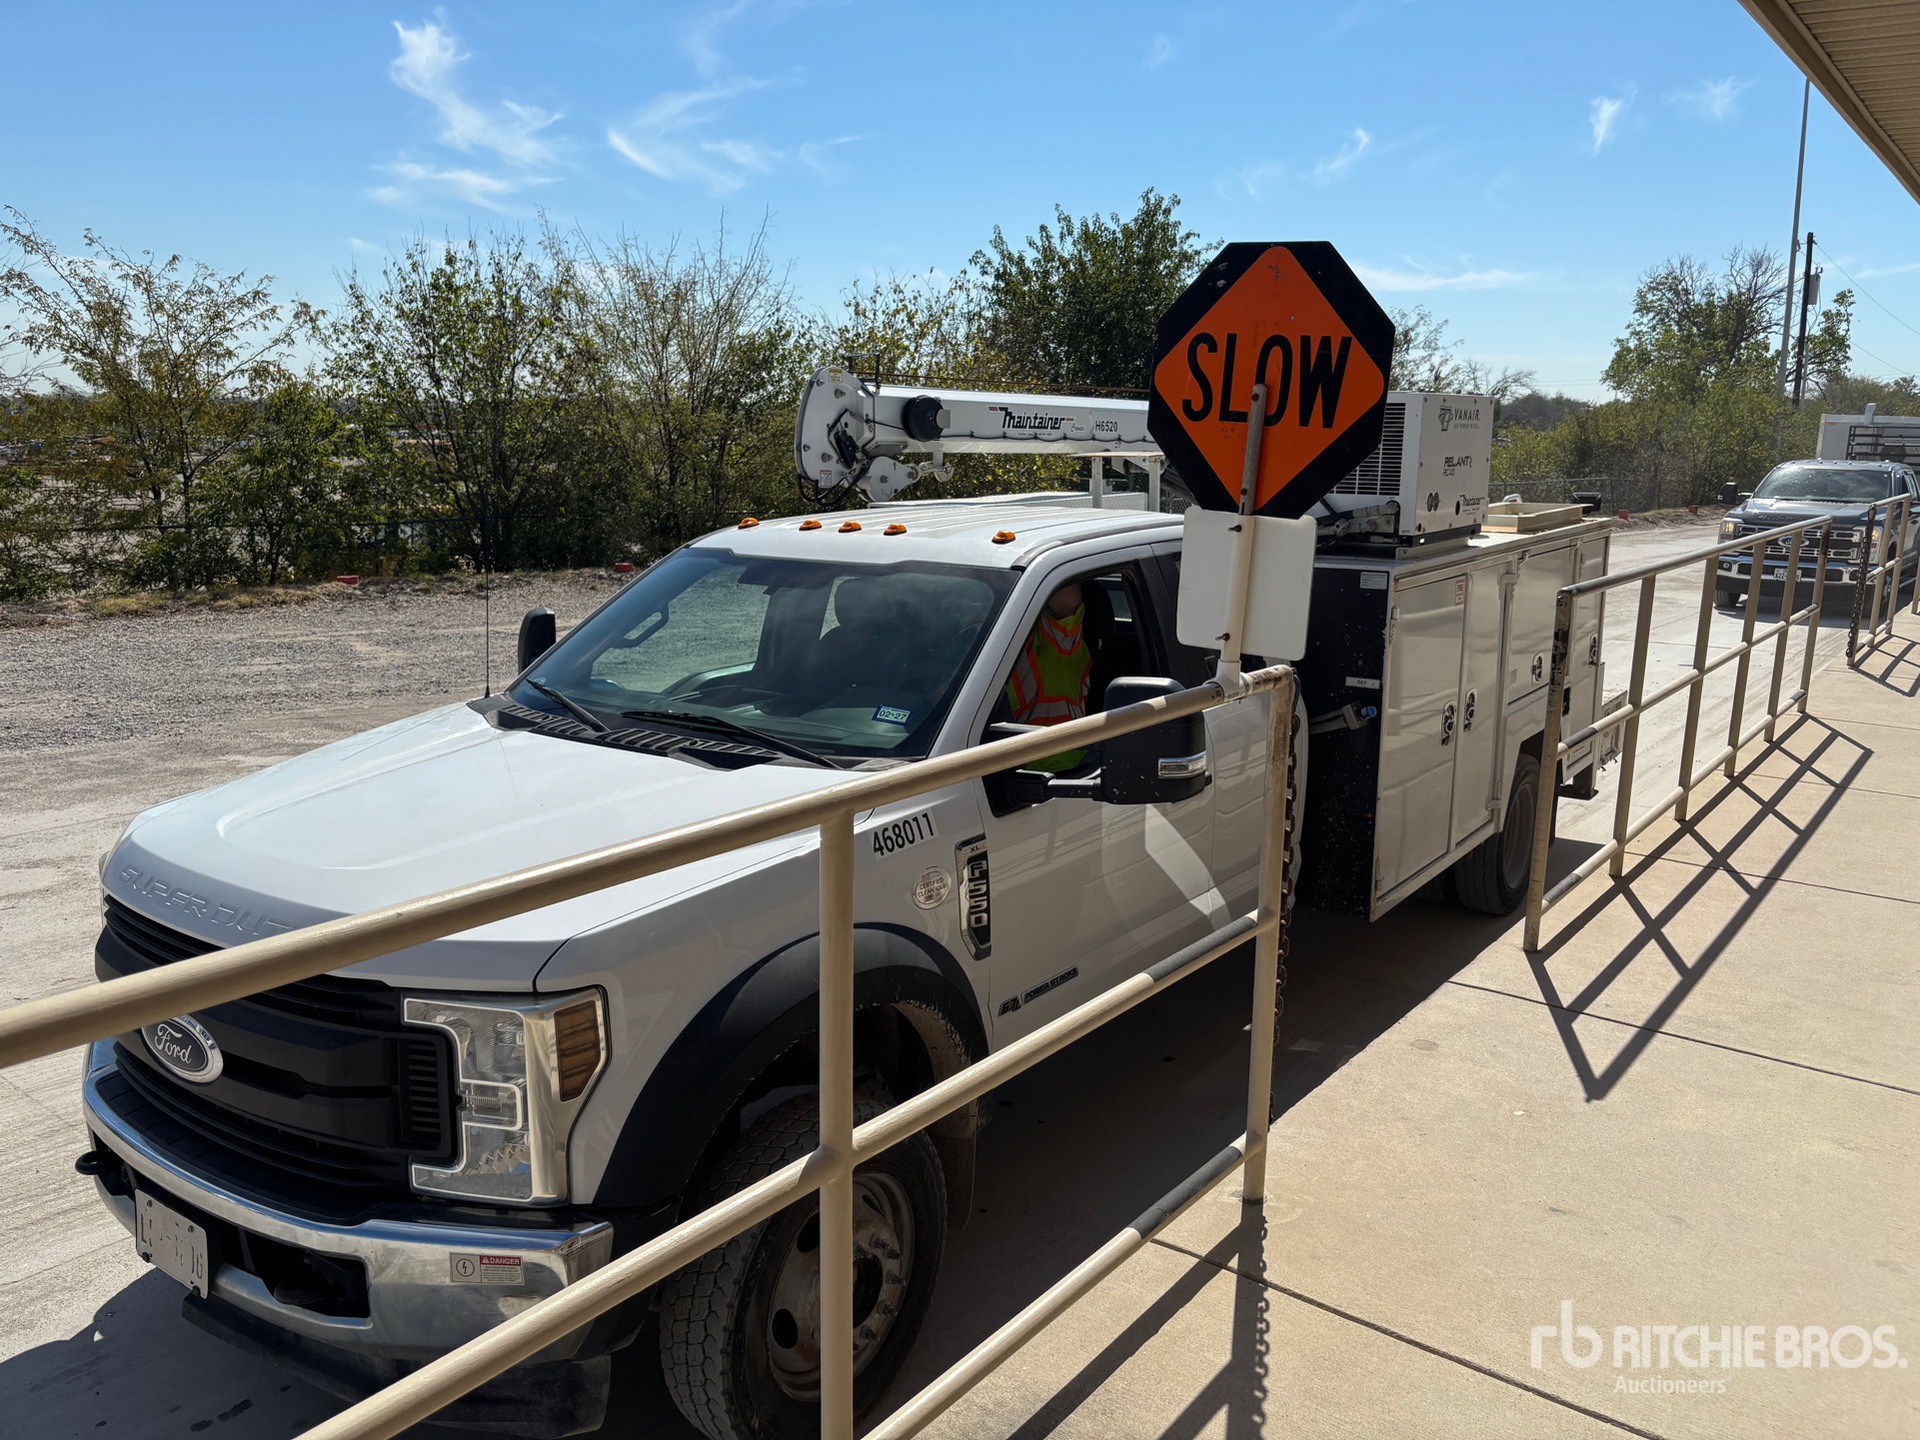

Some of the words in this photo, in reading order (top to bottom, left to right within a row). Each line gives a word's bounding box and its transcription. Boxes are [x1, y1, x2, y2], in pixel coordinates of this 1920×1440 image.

[1182, 332, 1352, 429] SLOW
[999, 407, 1066, 430] Maintainer
[1095, 421, 1118, 432] H6520
[1454, 409, 1480, 421] VANAIR
[873, 812, 934, 856] 468011
[119, 864, 211, 918] SUPER
[1024, 982, 1049, 1000] POWER
[1050, 967, 1078, 987] STROKE
[155, 1023, 192, 1064] Ford
[490, 1257, 520, 1265] DANGER
